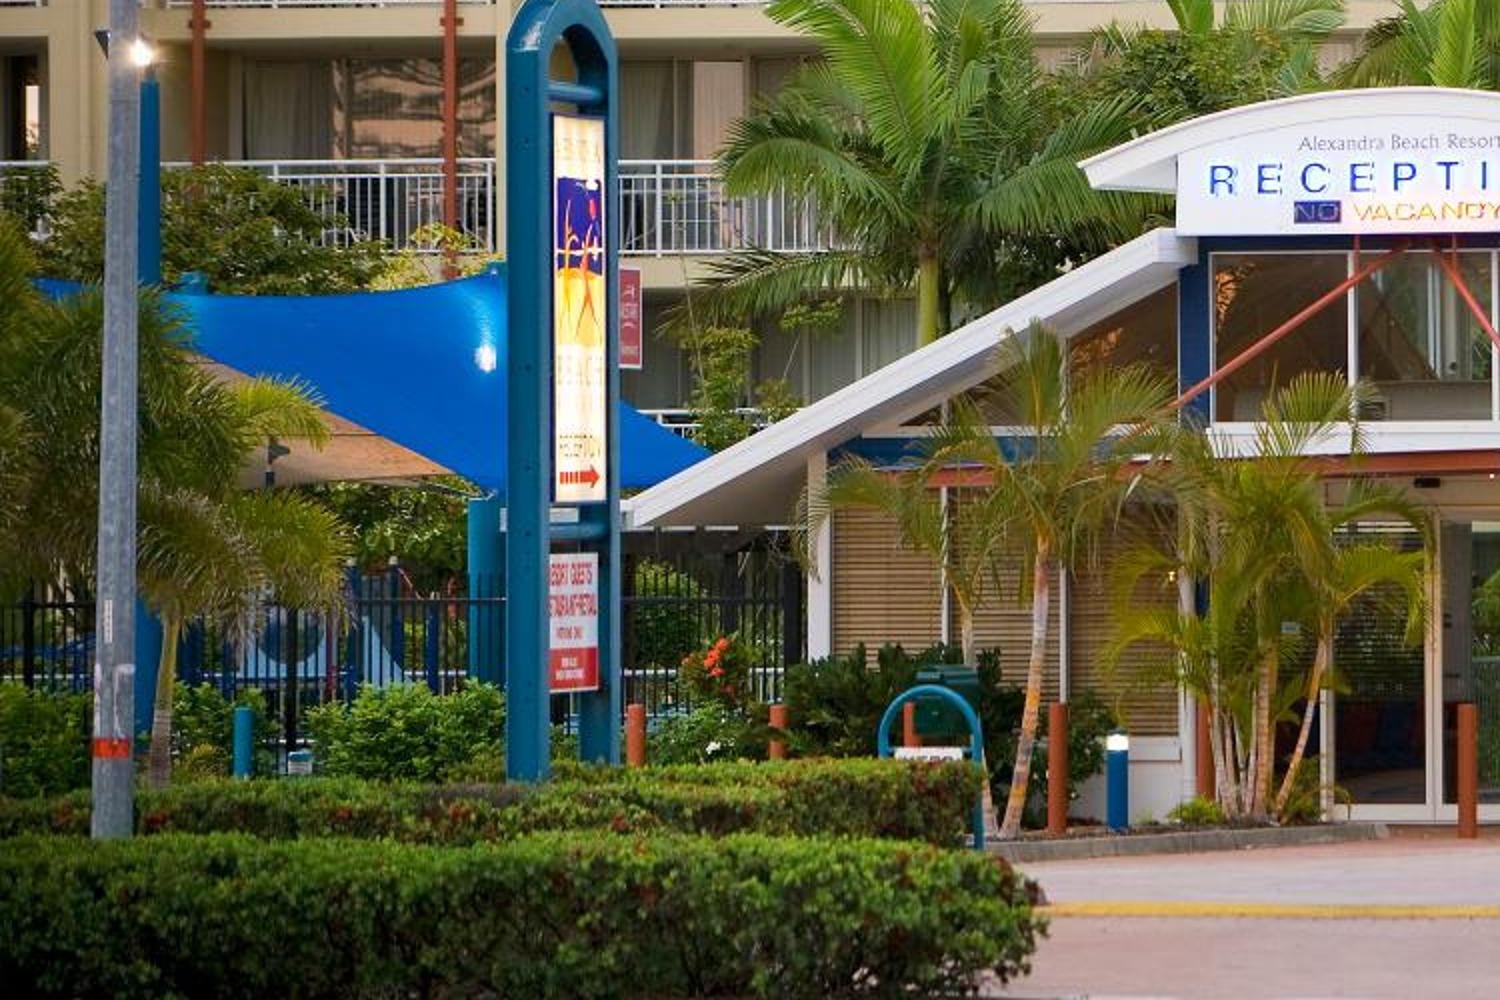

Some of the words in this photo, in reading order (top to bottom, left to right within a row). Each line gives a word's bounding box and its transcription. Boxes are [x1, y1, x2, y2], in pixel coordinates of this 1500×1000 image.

[1298, 135, 1385, 151] Alexandra
[1391, 133, 1439, 150] Beach
[1295, 202, 1340, 222] NO
